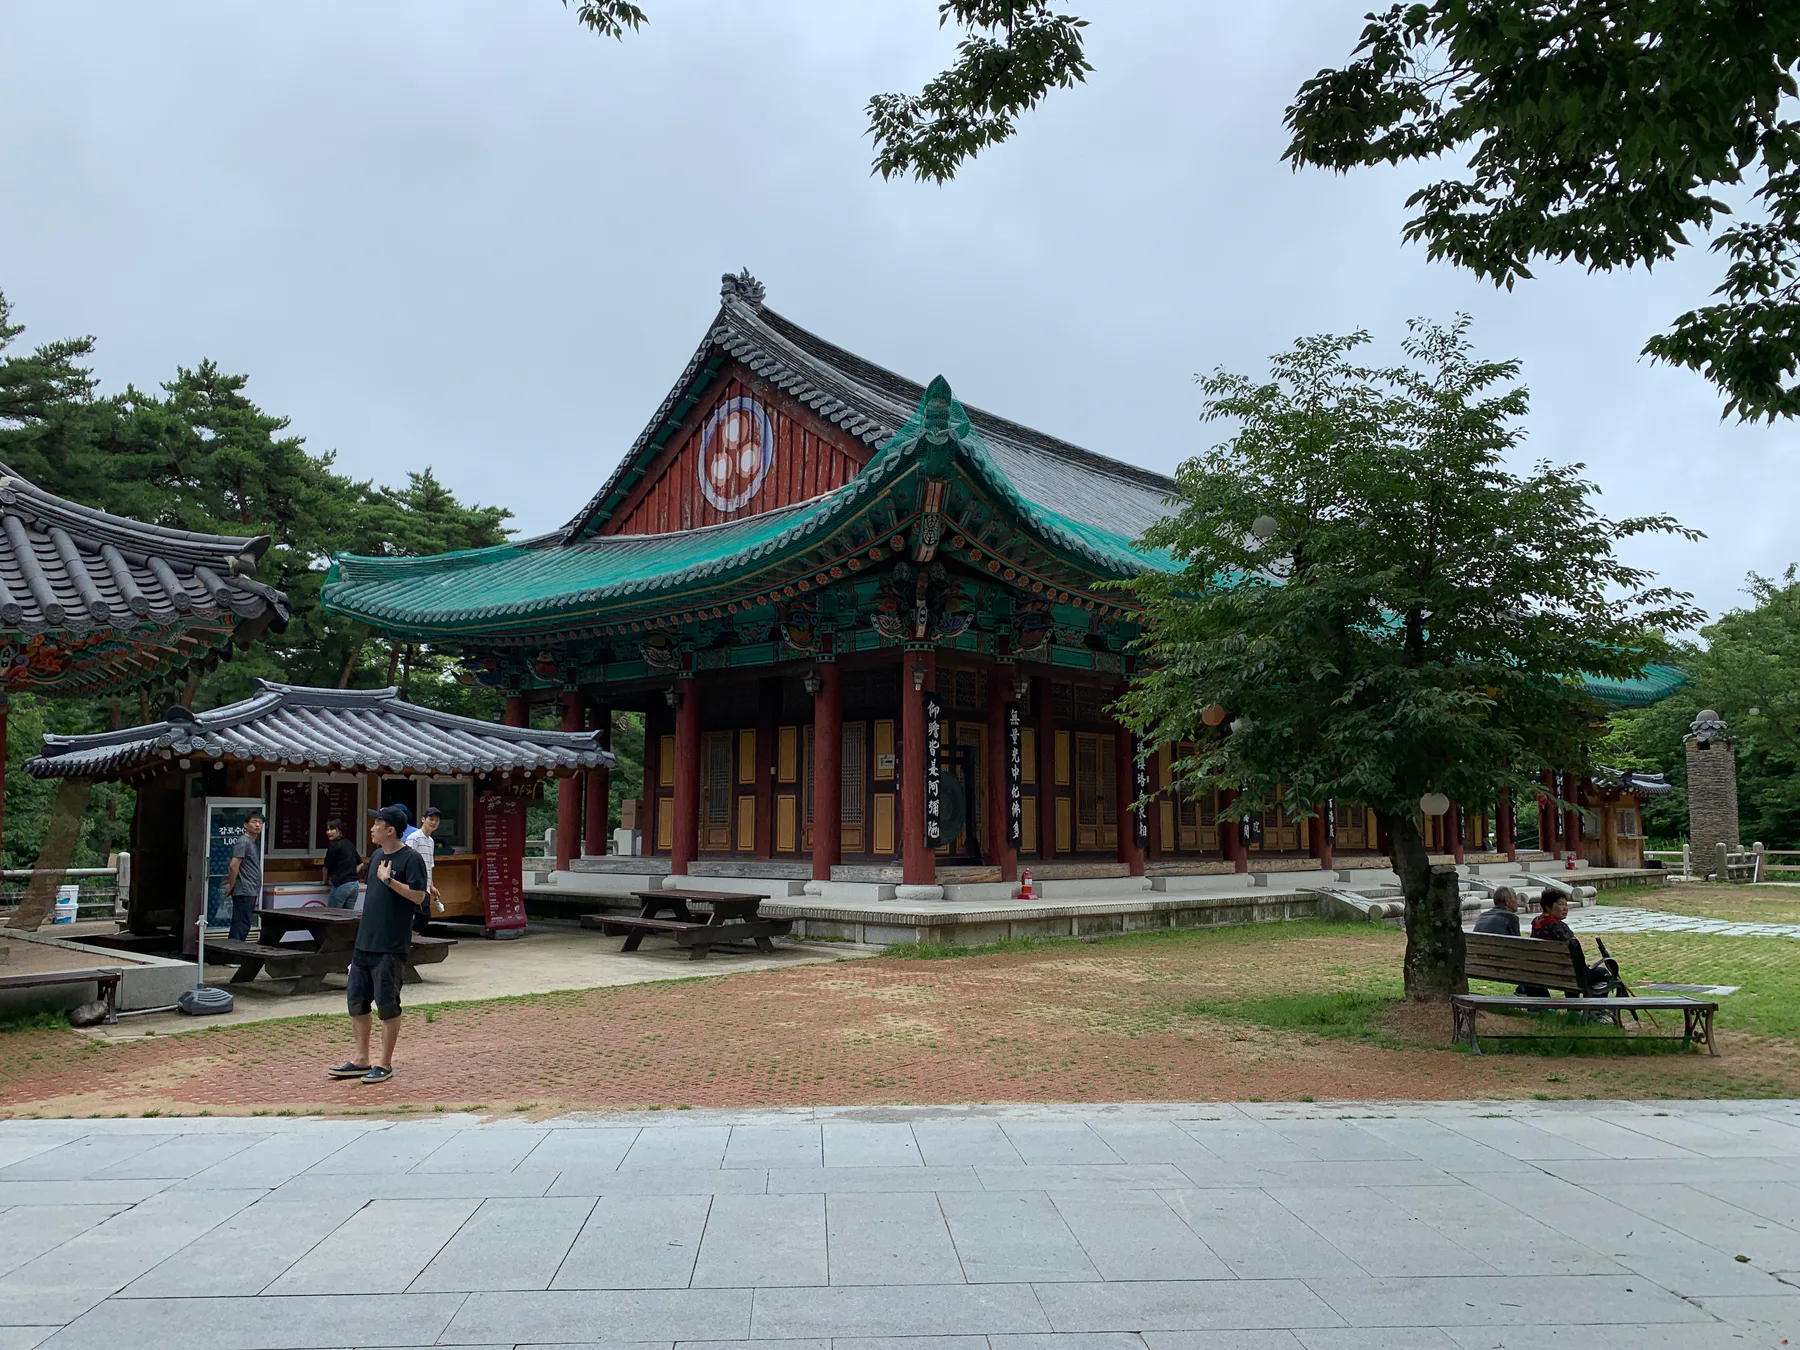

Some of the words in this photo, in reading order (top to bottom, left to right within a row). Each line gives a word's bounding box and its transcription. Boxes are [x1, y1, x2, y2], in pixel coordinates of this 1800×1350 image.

[1010, 708, 1021, 839] 無量光中化佛多
